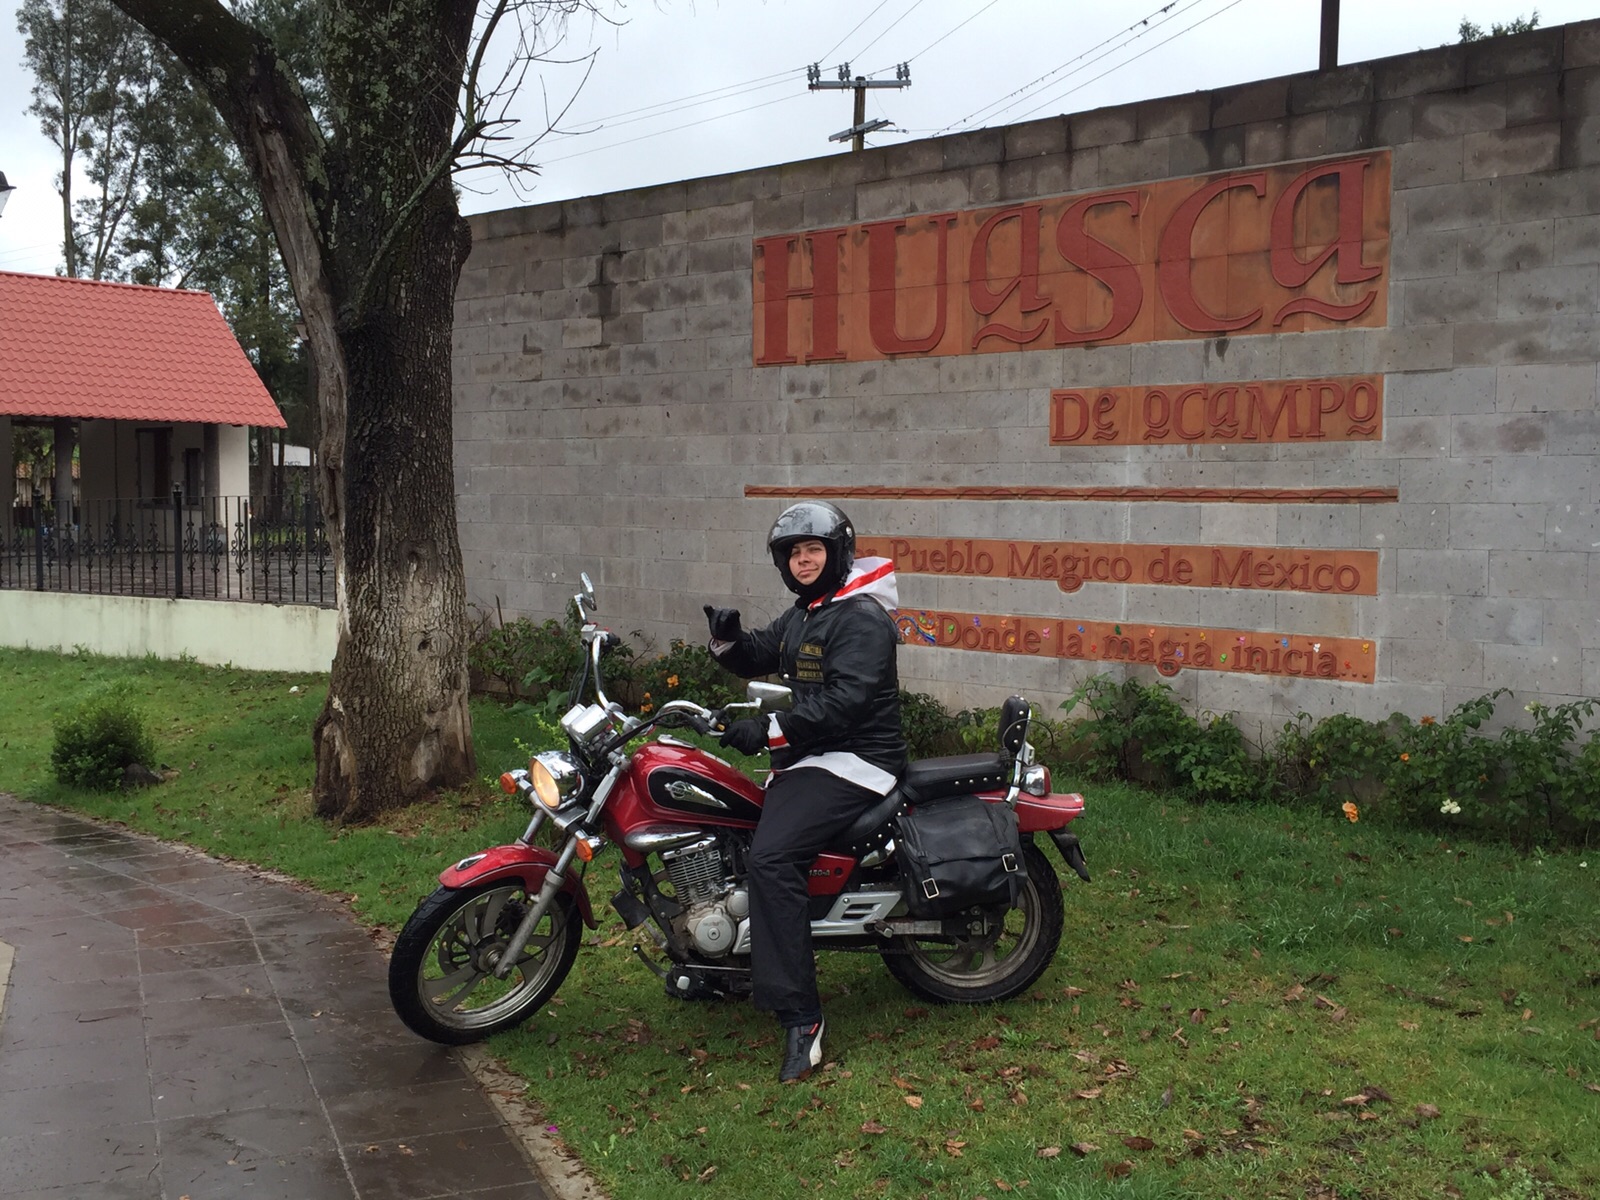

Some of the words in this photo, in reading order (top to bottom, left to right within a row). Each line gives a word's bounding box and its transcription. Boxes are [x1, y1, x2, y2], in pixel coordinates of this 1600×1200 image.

[890, 539, 994, 574] Pueblo
[1007, 543, 1133, 592] Mágico
[1147, 547, 1193, 584] de
[1211, 549, 1361, 592] México
[936, 614, 1041, 654] Donde
[1056, 621, 1085, 657] la
[1102, 632, 1213, 677] magia
